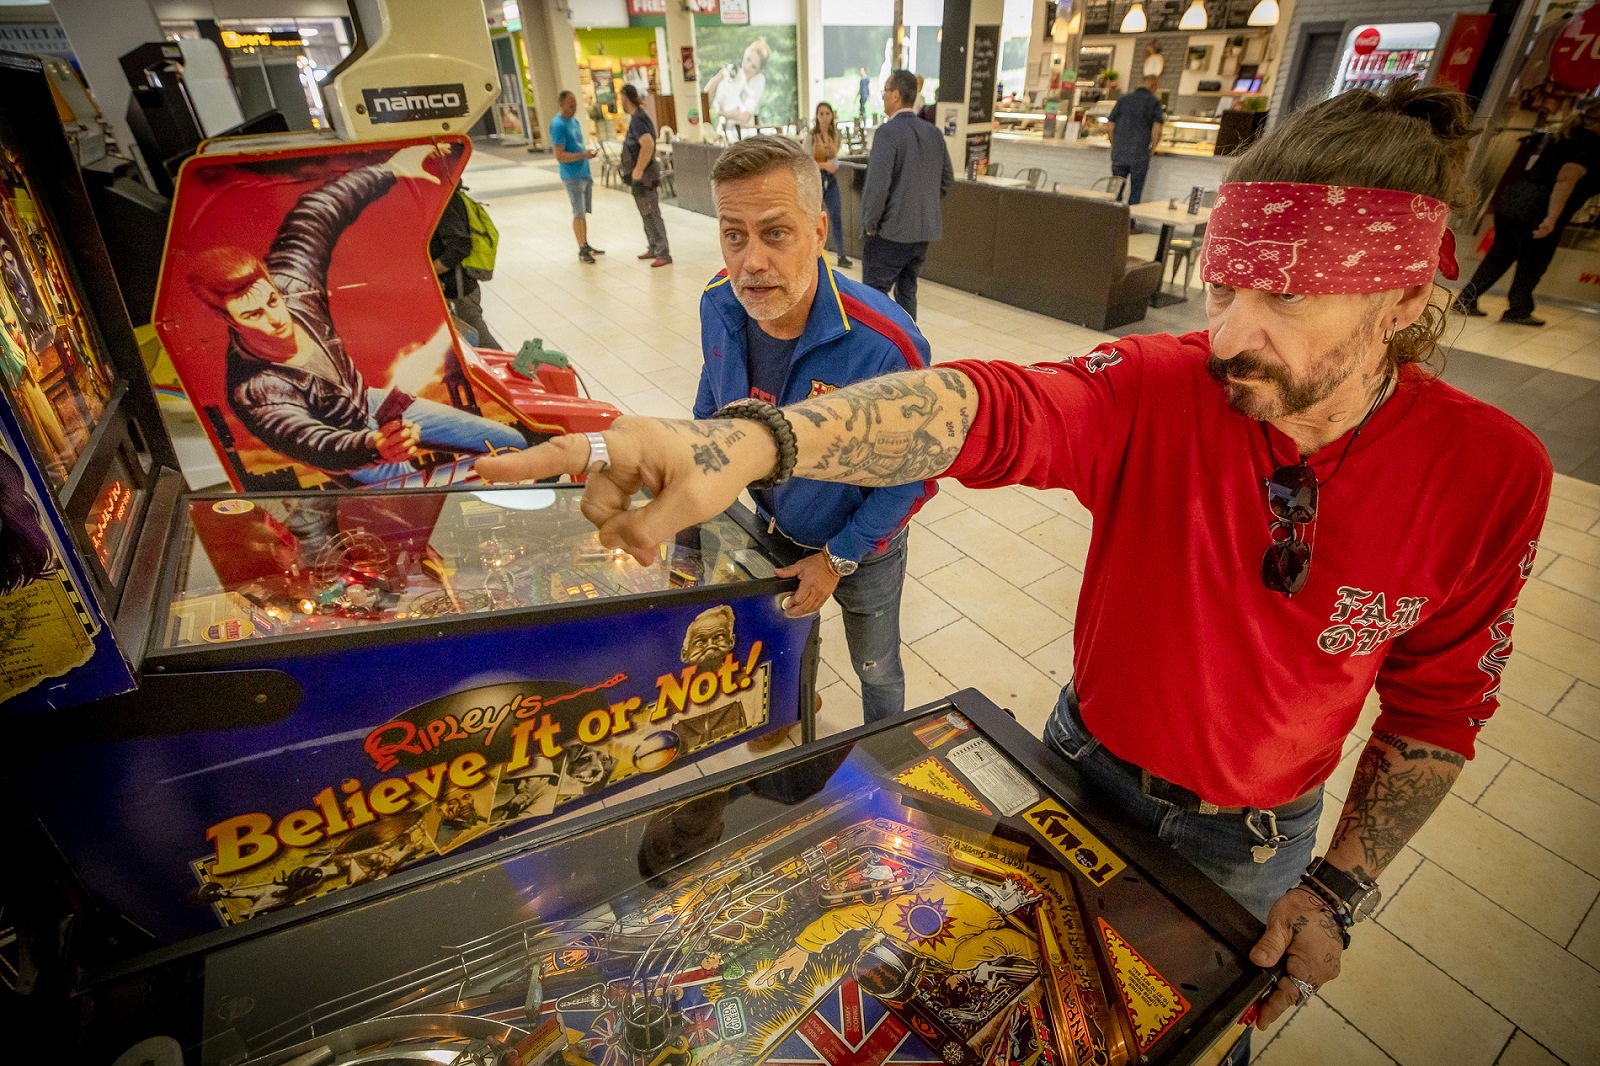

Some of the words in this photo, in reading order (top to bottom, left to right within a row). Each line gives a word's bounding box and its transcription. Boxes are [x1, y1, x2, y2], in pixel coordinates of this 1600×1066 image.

[373, 93, 460, 112] namco
[206, 750, 490, 875] Believe
[505, 713, 563, 772] It
[578, 698, 641, 744] or
[650, 640, 763, 721] Not!
[961, 844, 986, 858] SILVER
[1028, 869, 1046, 885] BOY
[1042, 883, 1065, 905] YOUNG
[1062, 913, 1075, 930] WAS
[1068, 937, 1085, 960] SINCE
[1073, 964, 1093, 991] EVER
[724, 1008, 733, 1028] ACID
[730, 1003, 741, 1029] QUEEN
[803, 1023, 821, 1041] FIDDLE
[808, 1018, 826, 1035] ABOUT
[880, 1024, 899, 1043] SALLY
[821, 1046, 839, 1064] SMASH
